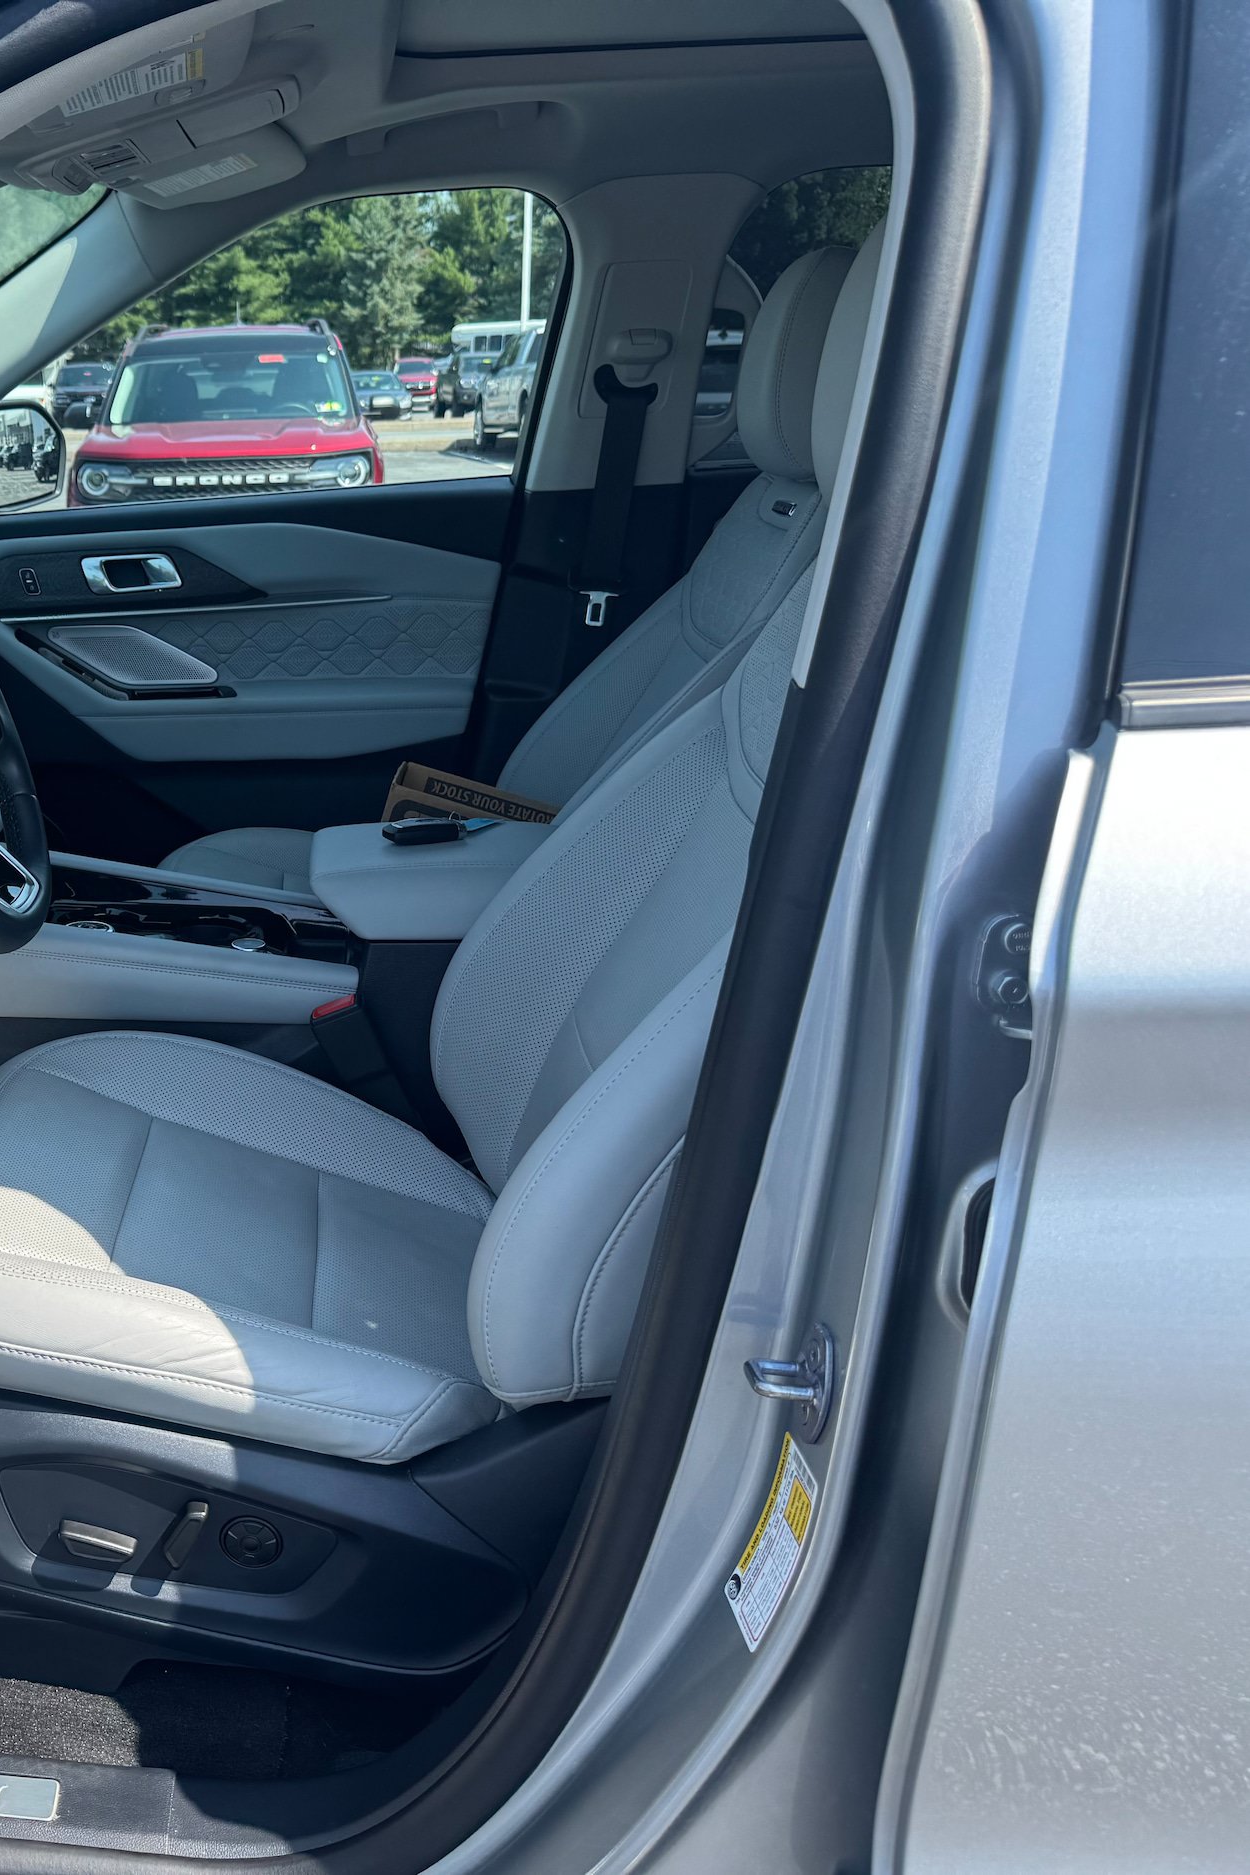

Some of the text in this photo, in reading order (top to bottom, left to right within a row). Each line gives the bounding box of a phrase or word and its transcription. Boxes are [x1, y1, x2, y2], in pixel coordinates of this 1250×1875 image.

[432, 781, 473, 802] STOCK
[472, 792, 507, 814] YOUR
[740, 1552, 751, 1570] TIRE
[750, 1533, 759, 1551] AND
[758, 1499, 774, 1533] LOADING
